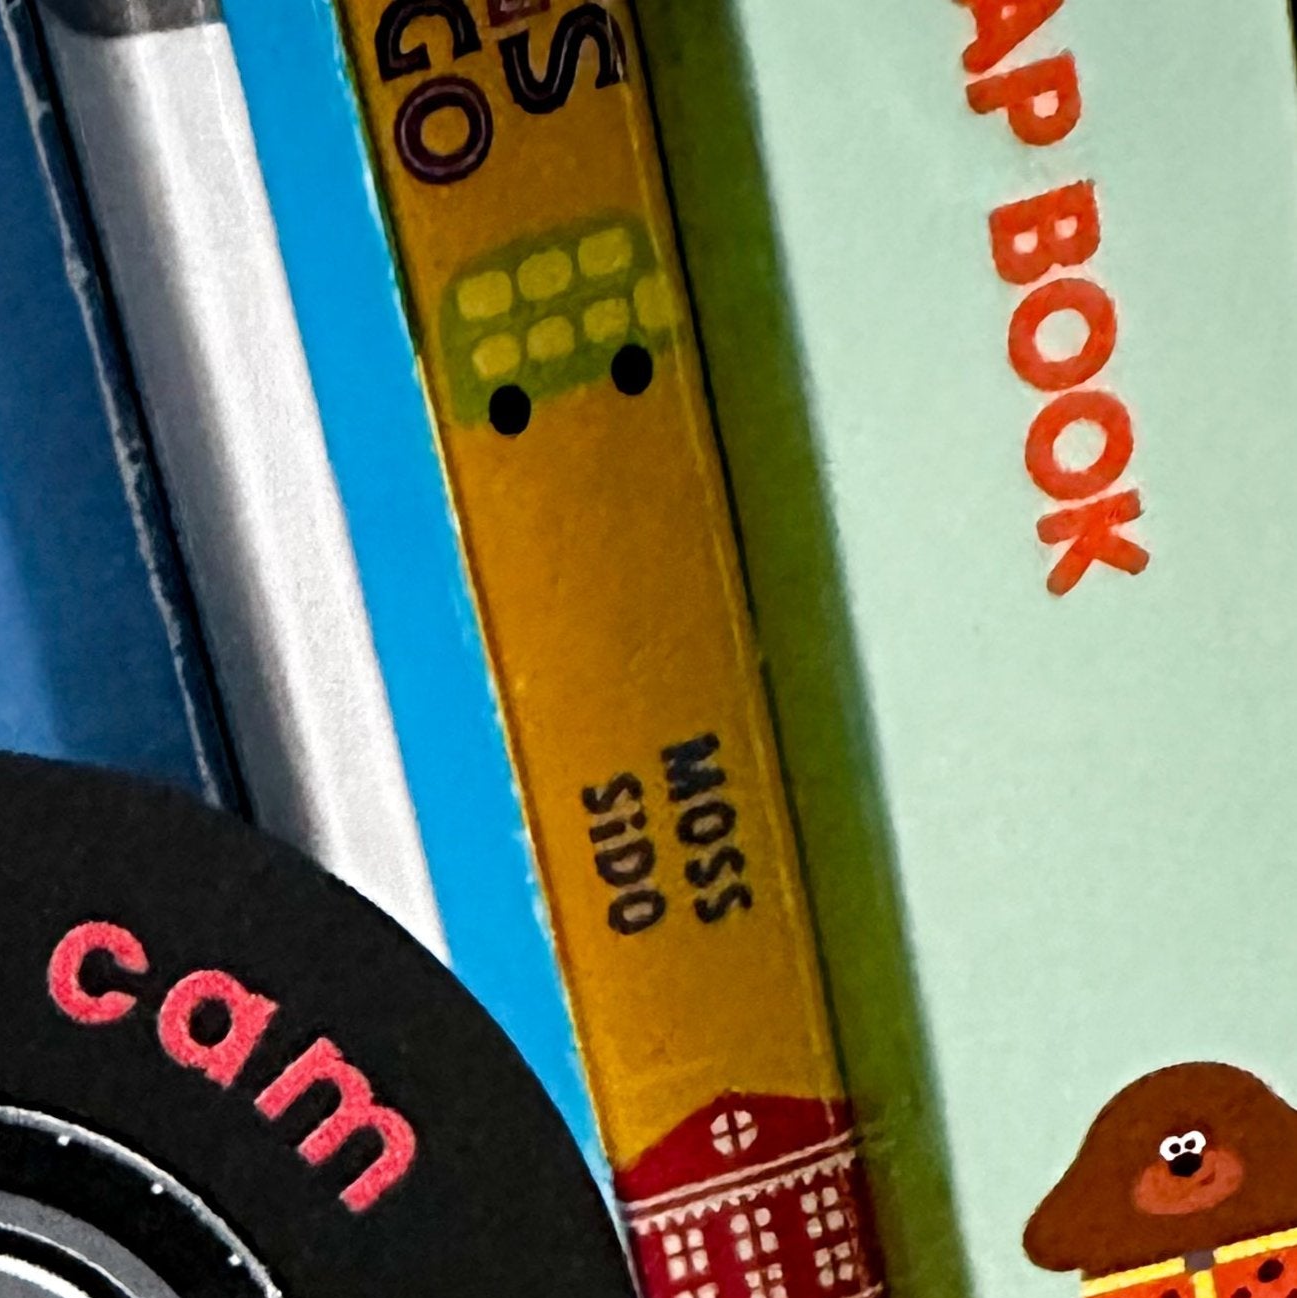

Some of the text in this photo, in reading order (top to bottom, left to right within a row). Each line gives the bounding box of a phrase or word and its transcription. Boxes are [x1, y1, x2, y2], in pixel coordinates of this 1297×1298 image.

[375, 0, 494, 185] GO
[487, 0, 628, 114] S
[988, 179, 1151, 597] BOOK
[660, 732, 753, 924] MOSS
[47, 920, 417, 1213] cam
